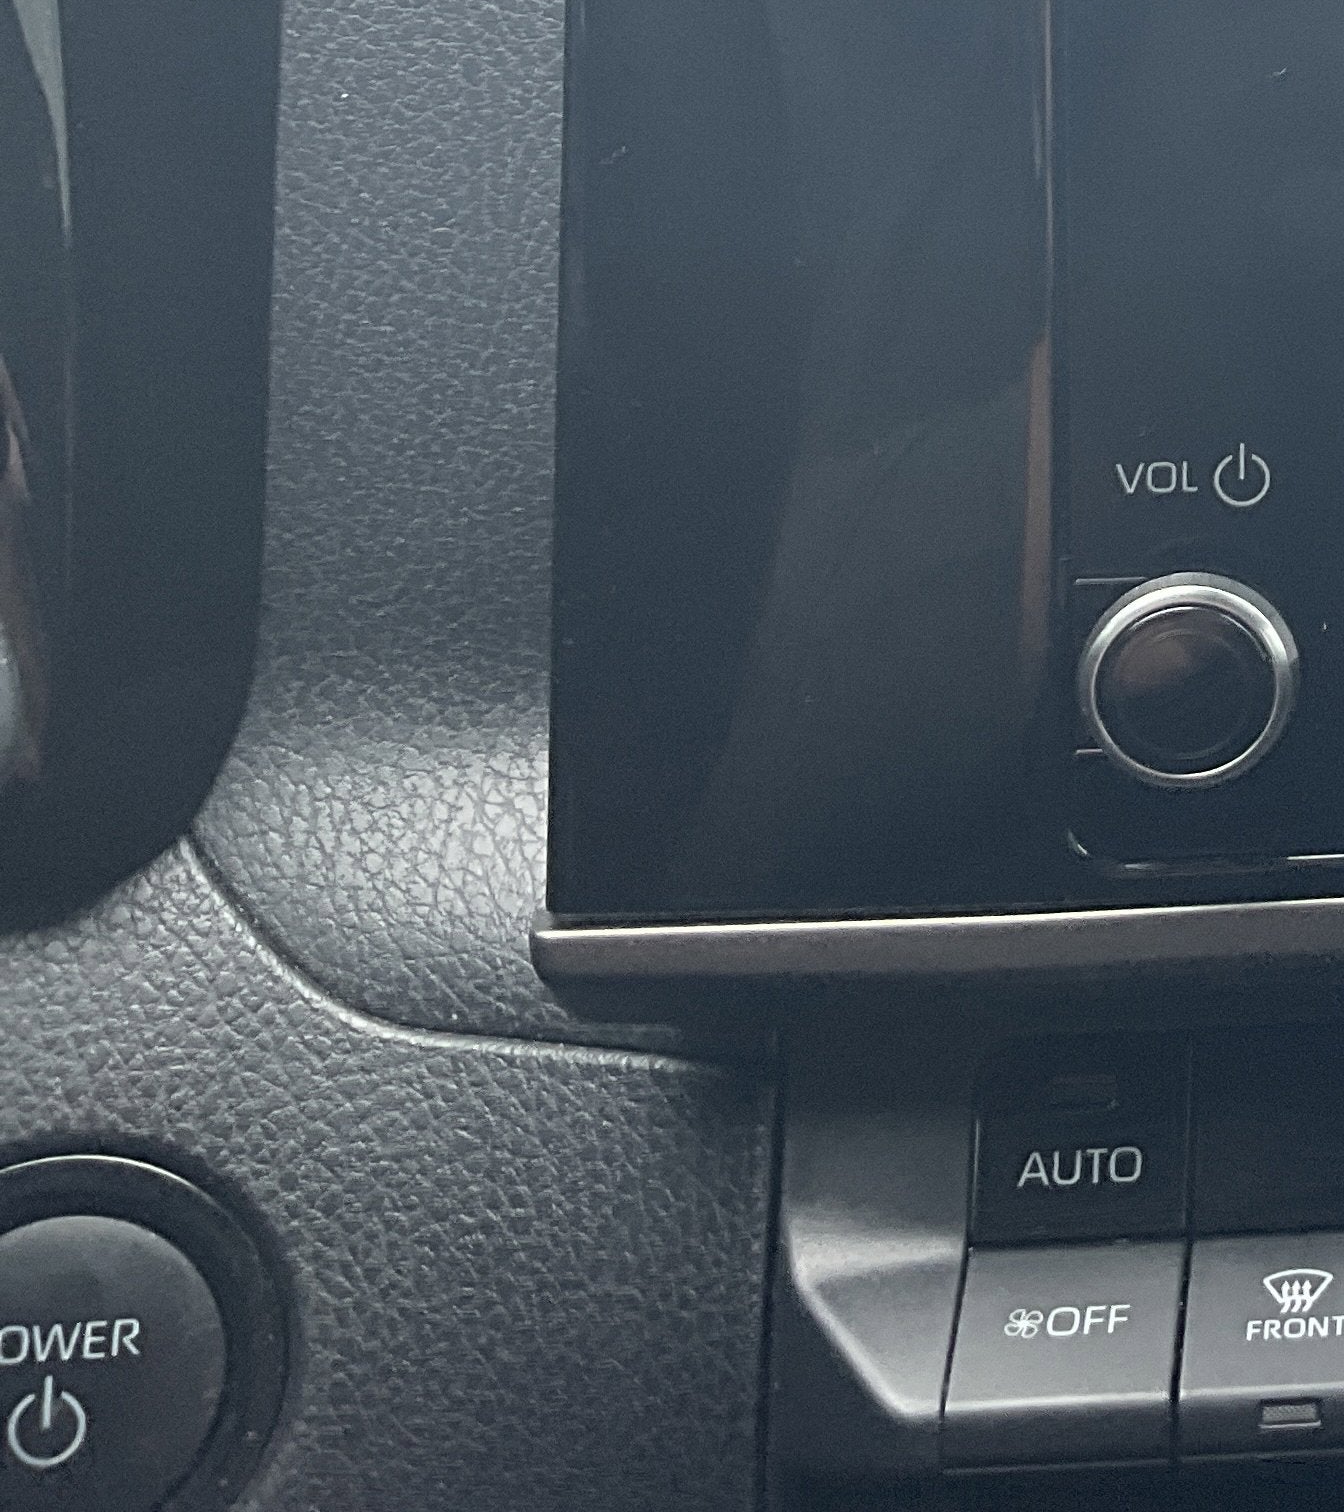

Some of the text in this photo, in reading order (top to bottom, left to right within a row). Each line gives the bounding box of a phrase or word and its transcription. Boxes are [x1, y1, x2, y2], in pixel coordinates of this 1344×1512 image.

[1115, 461, 1198, 496] VOL
[1017, 1145, 1144, 1188] AUTO
[1046, 1304, 1131, 1338] OFF
[0, 1318, 140, 1365] OWER
